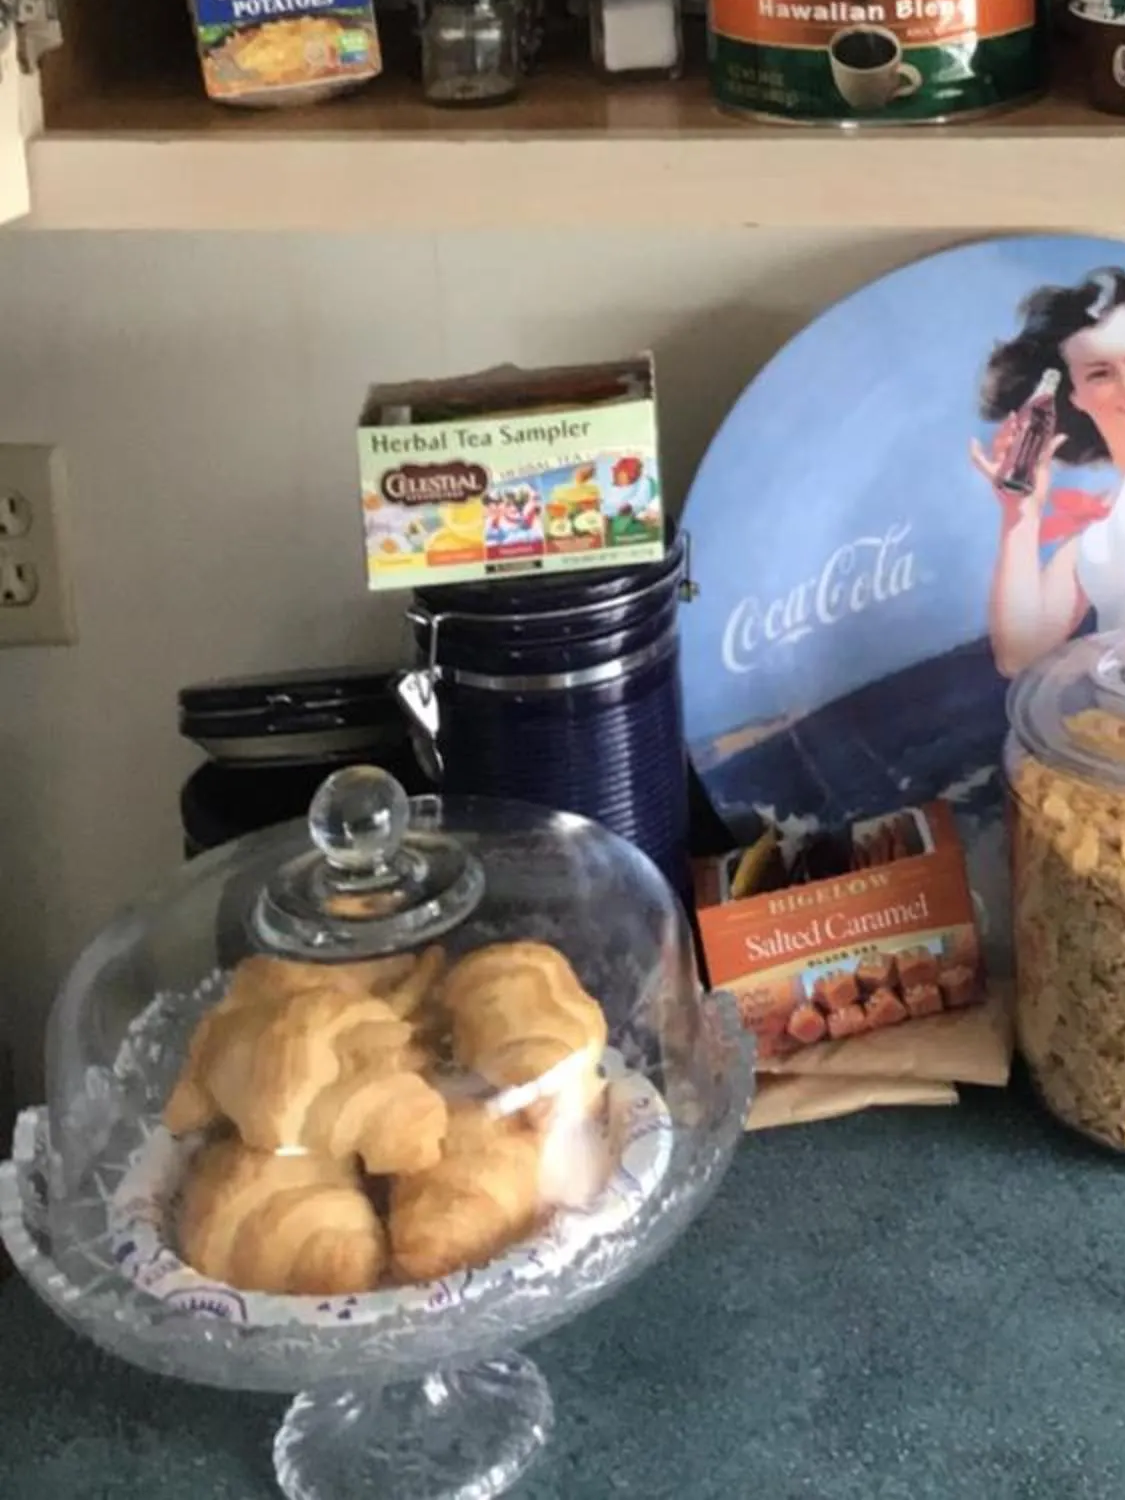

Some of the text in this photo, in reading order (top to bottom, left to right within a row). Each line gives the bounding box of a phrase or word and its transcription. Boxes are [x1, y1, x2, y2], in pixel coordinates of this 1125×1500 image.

[371, 419, 591, 453] Herbal Tea Sampler
[768, 871, 893, 916] BIGELOW
[745, 892, 930, 961] Salted Caramel
